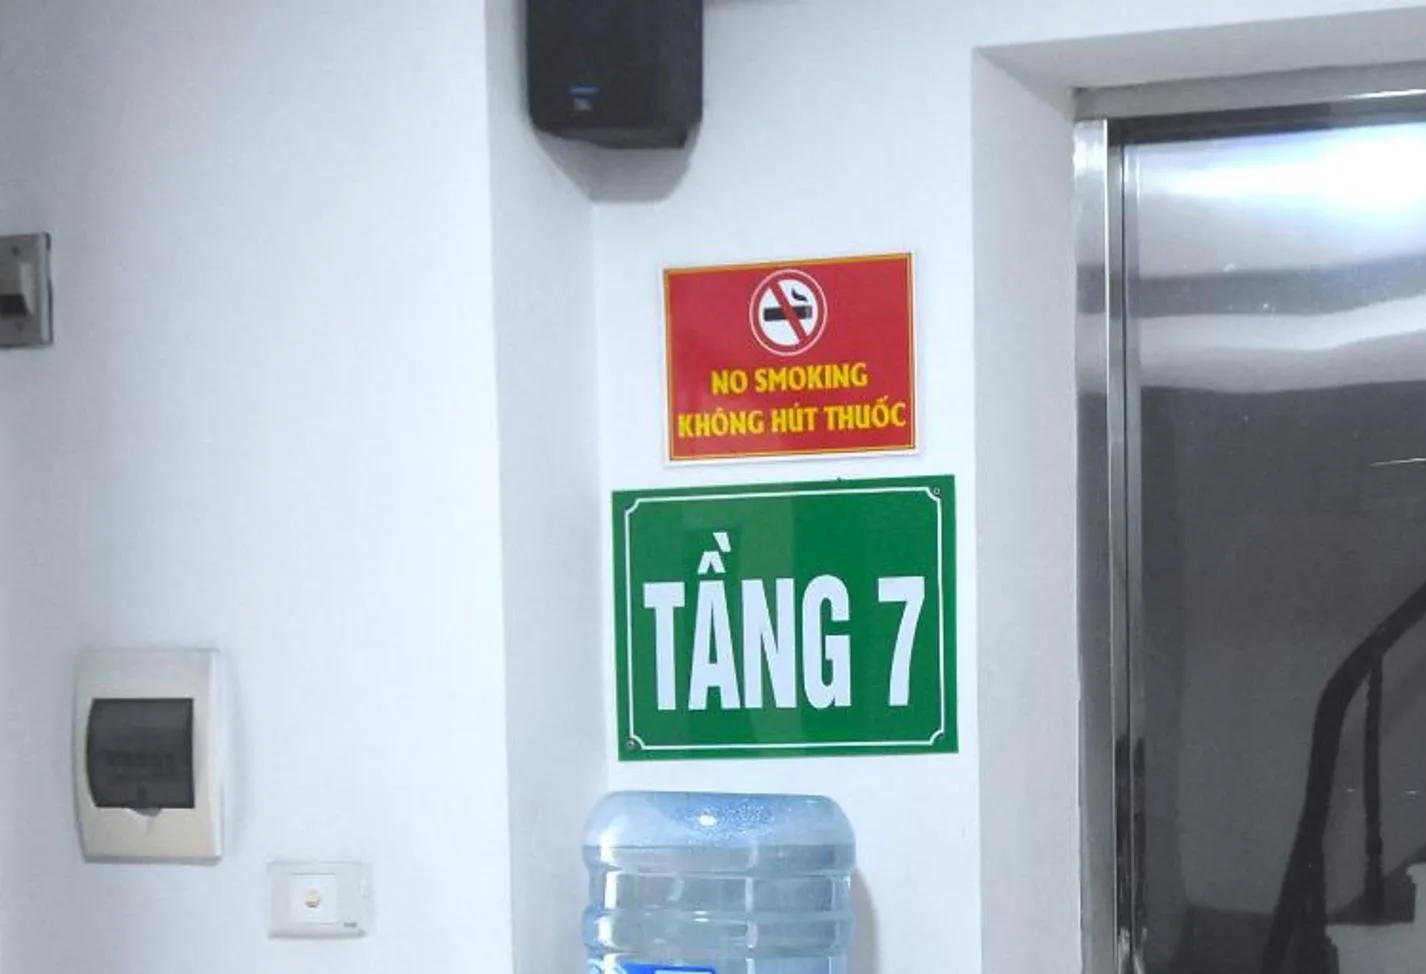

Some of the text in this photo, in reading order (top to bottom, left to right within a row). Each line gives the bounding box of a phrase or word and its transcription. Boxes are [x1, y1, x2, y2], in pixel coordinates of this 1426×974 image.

[711, 362, 868, 395] NO SMOKING
[677, 394, 907, 438] KHÔNG HÚT THUỐC
[643, 531, 926, 711] TẦNG 7
